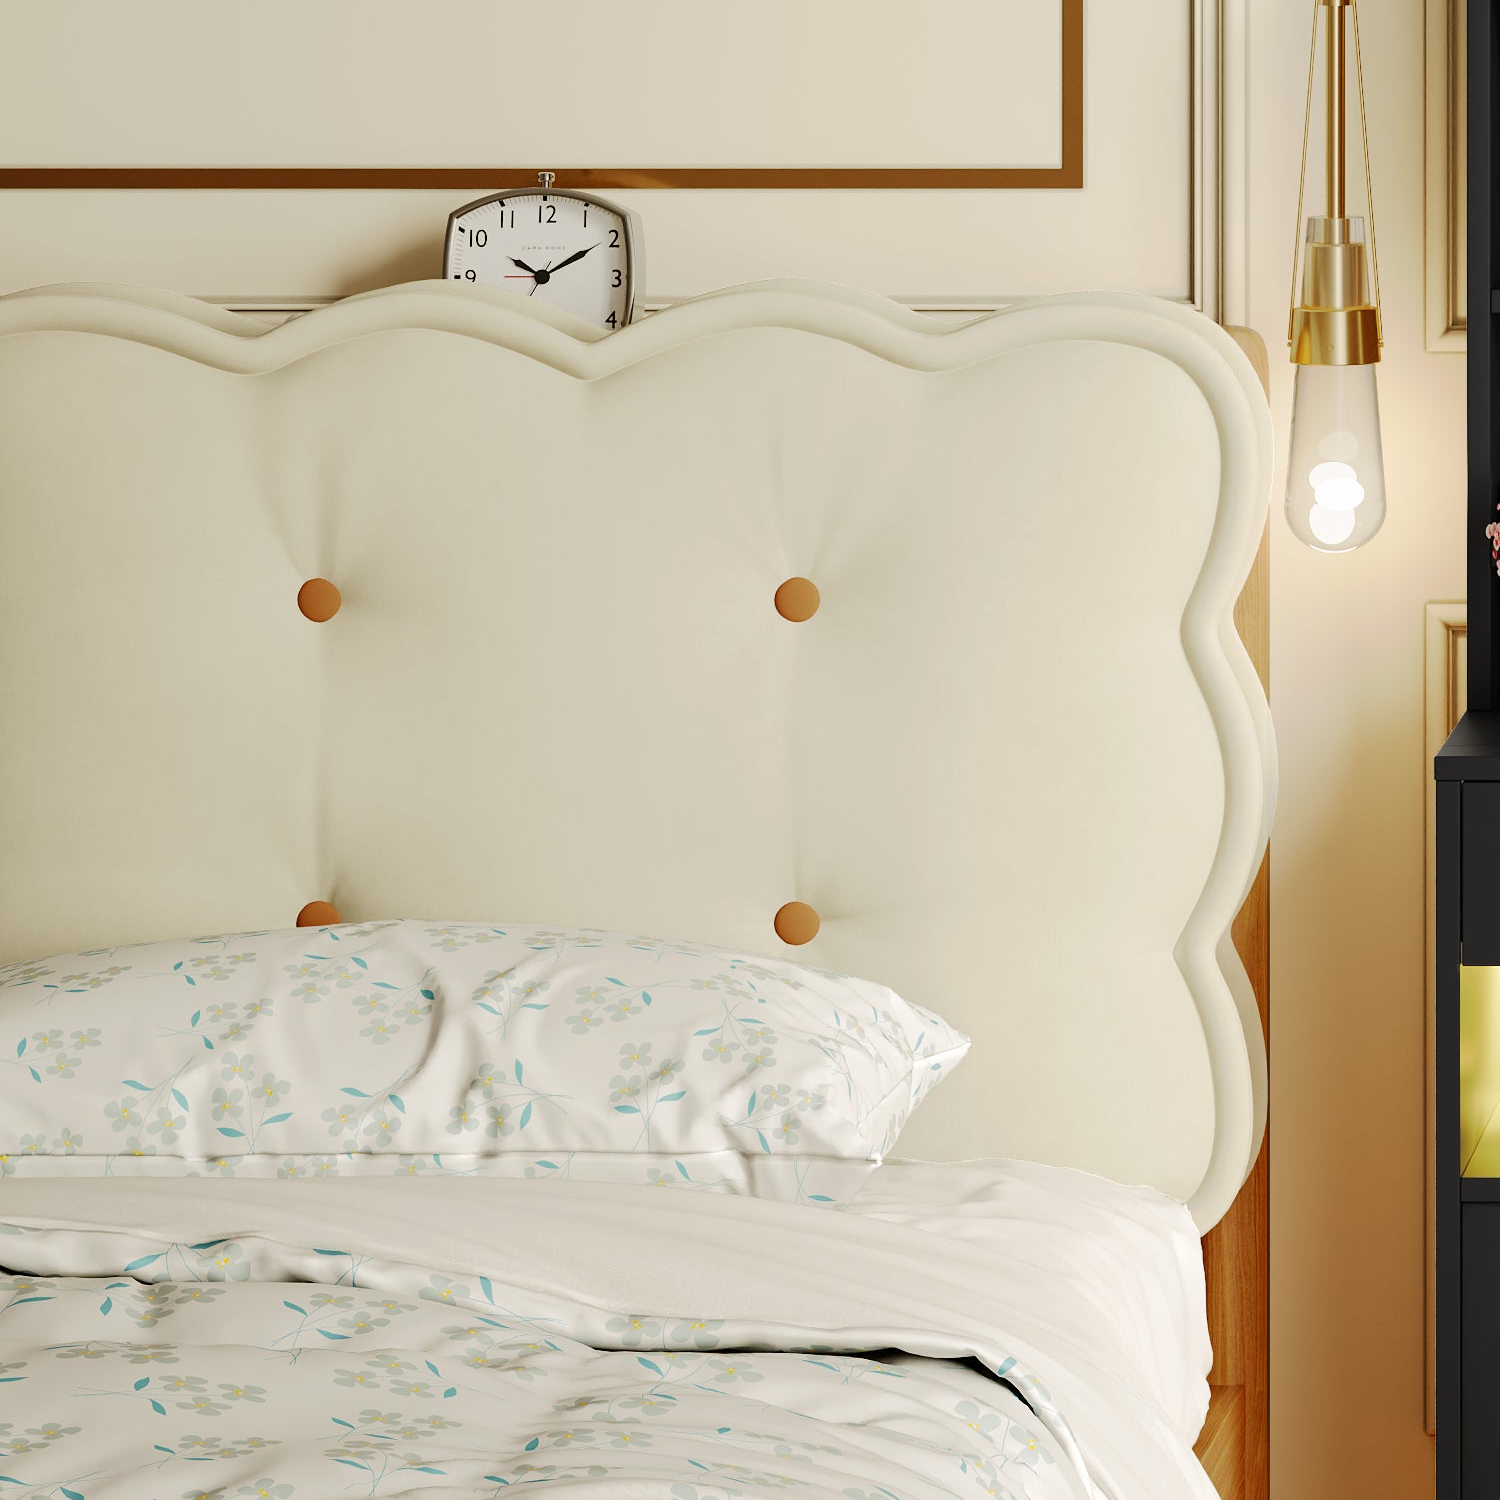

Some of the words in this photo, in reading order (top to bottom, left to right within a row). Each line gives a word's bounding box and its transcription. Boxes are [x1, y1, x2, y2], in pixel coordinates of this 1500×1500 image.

[500, 210, 514, 228] 11
[538, 205, 557, 224] 12
[583, 209, 587, 228] 1
[469, 229, 488, 248] 10
[608, 229, 620, 248] 2
[465, 269, 477, 283] 9
[611, 269, 622, 288] 3
[605, 310, 618, 329] 4
